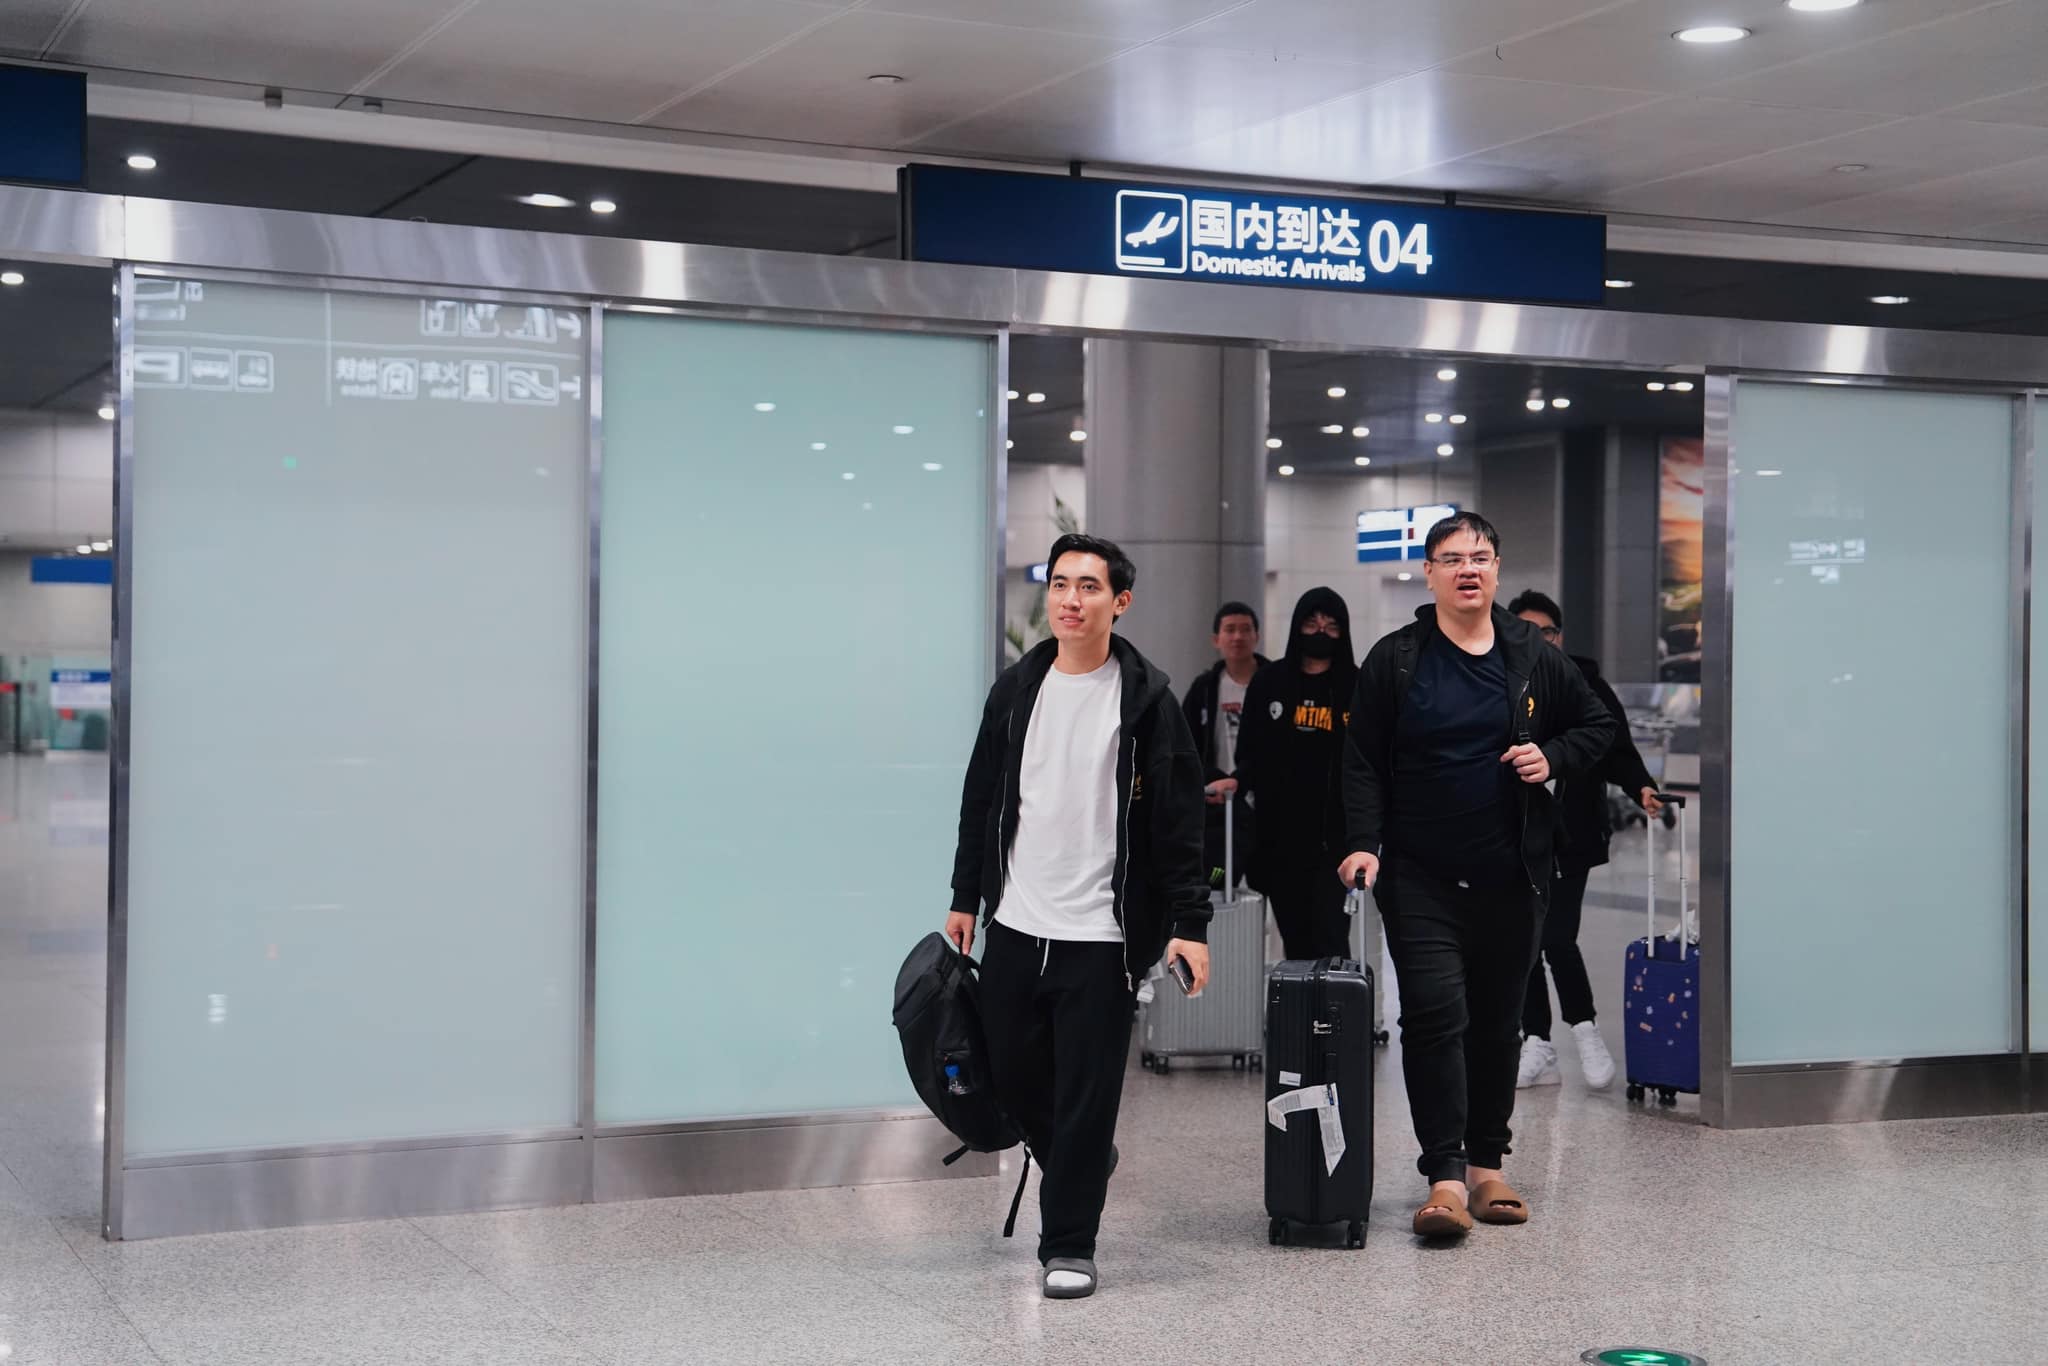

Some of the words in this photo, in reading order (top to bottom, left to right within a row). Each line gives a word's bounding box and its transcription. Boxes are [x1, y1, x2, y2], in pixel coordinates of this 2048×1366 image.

[1192, 199, 1361, 256] 国内到达
[1369, 219, 1433, 275] 04
[1191, 250, 1288, 278] Domestic
[1289, 257, 1366, 283] Arrivals
